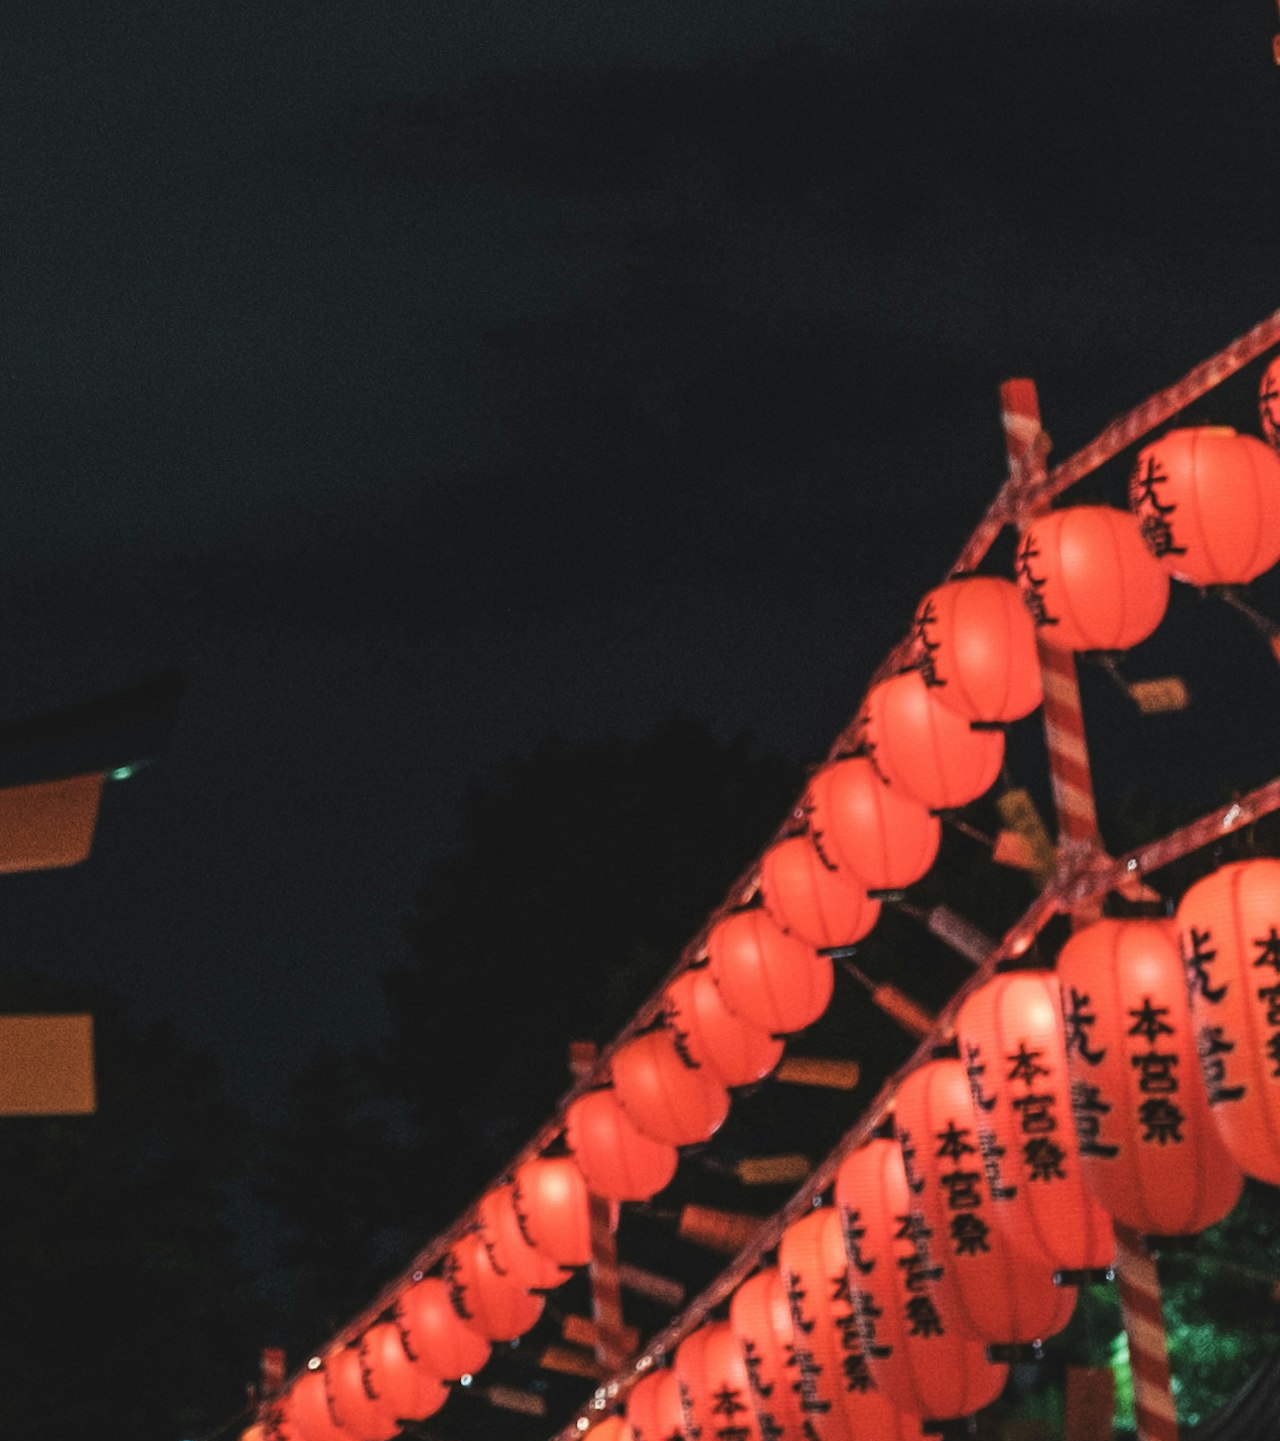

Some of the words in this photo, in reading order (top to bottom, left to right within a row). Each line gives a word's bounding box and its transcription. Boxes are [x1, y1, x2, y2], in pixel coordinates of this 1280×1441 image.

[1008, 1043, 1068, 1183] 本宮祭
[1127, 997, 1186, 1146] 本宮祭
[935, 1120, 992, 1257] 本宮祭
